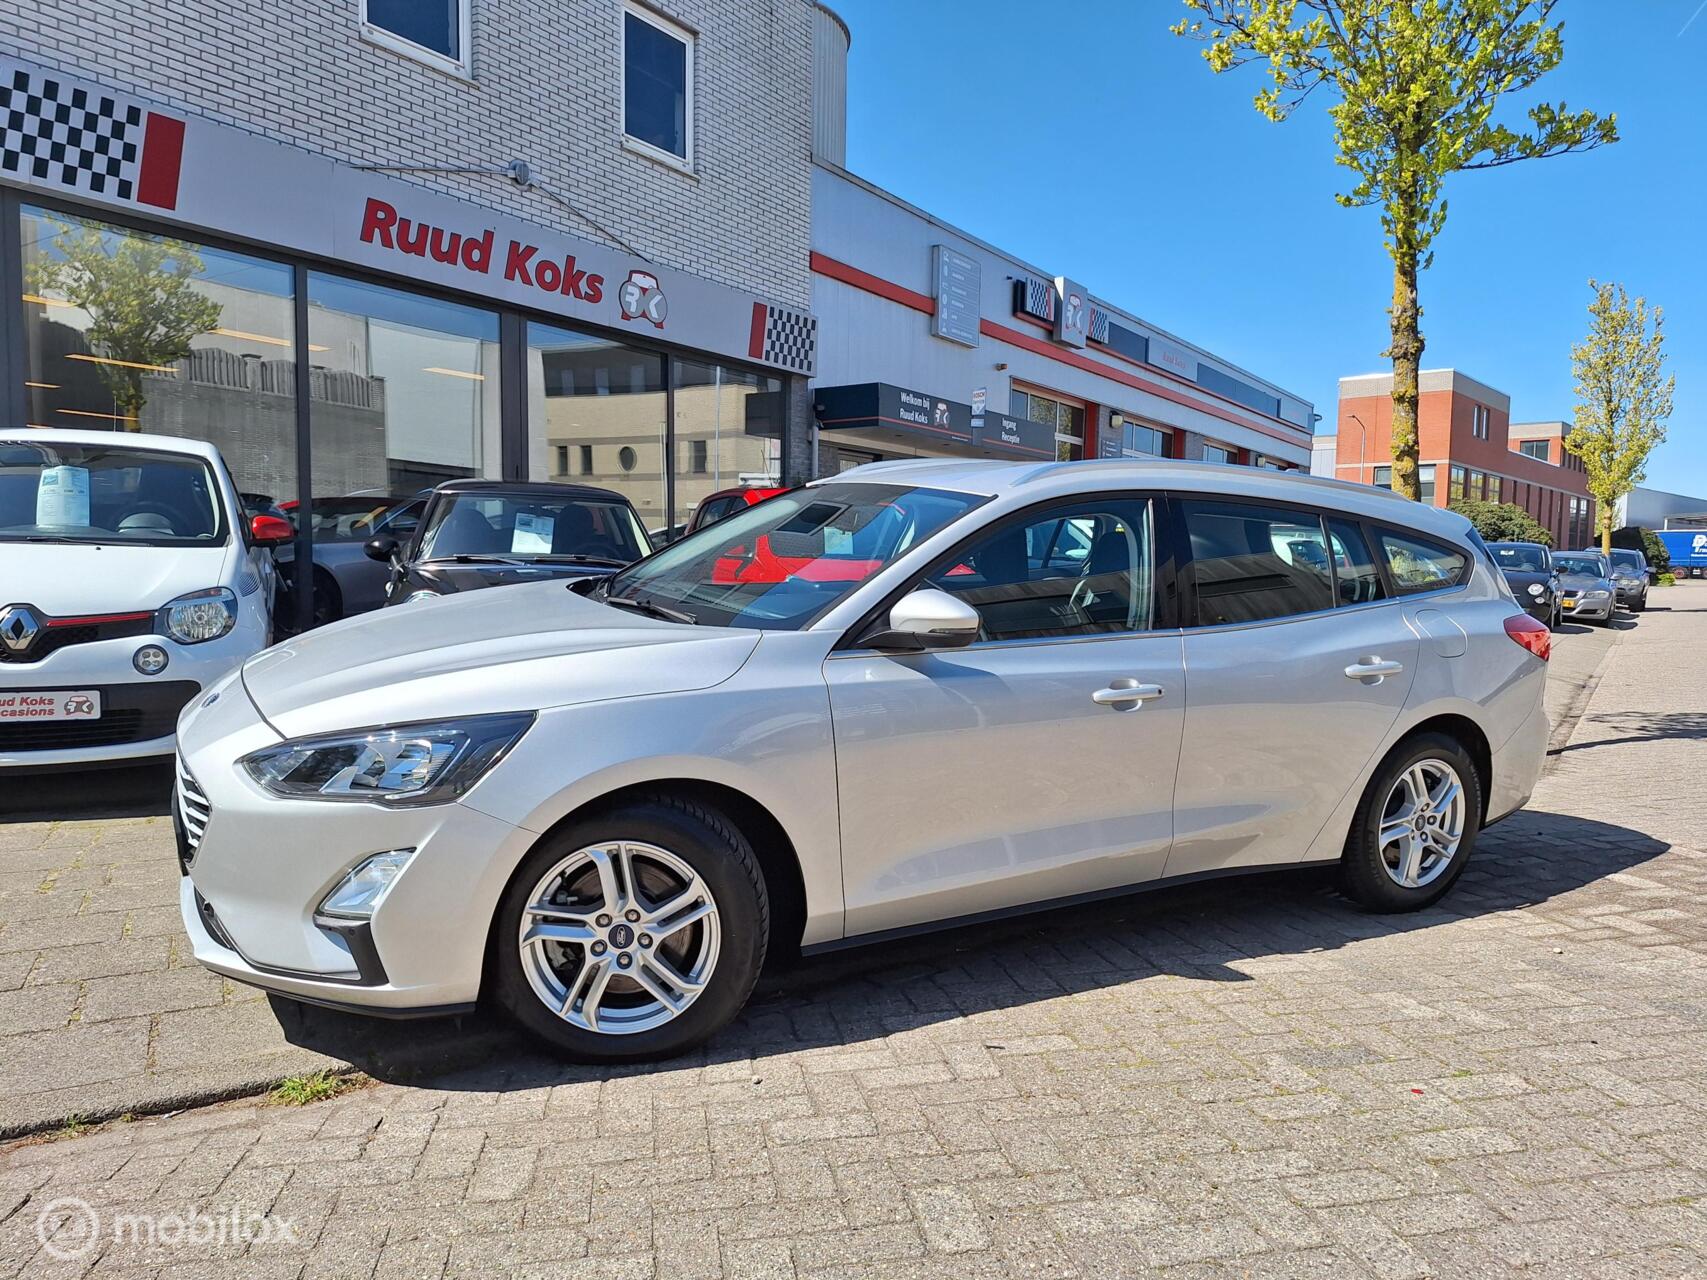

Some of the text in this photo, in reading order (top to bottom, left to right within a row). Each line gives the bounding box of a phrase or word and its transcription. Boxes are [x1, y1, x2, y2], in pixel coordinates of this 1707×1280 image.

[360, 197, 604, 304] Ruud Koks
[900, 391, 923, 407] Welkom
[900, 408, 928, 424] Ruud Koks
[19, 696, 55, 706] Koks
